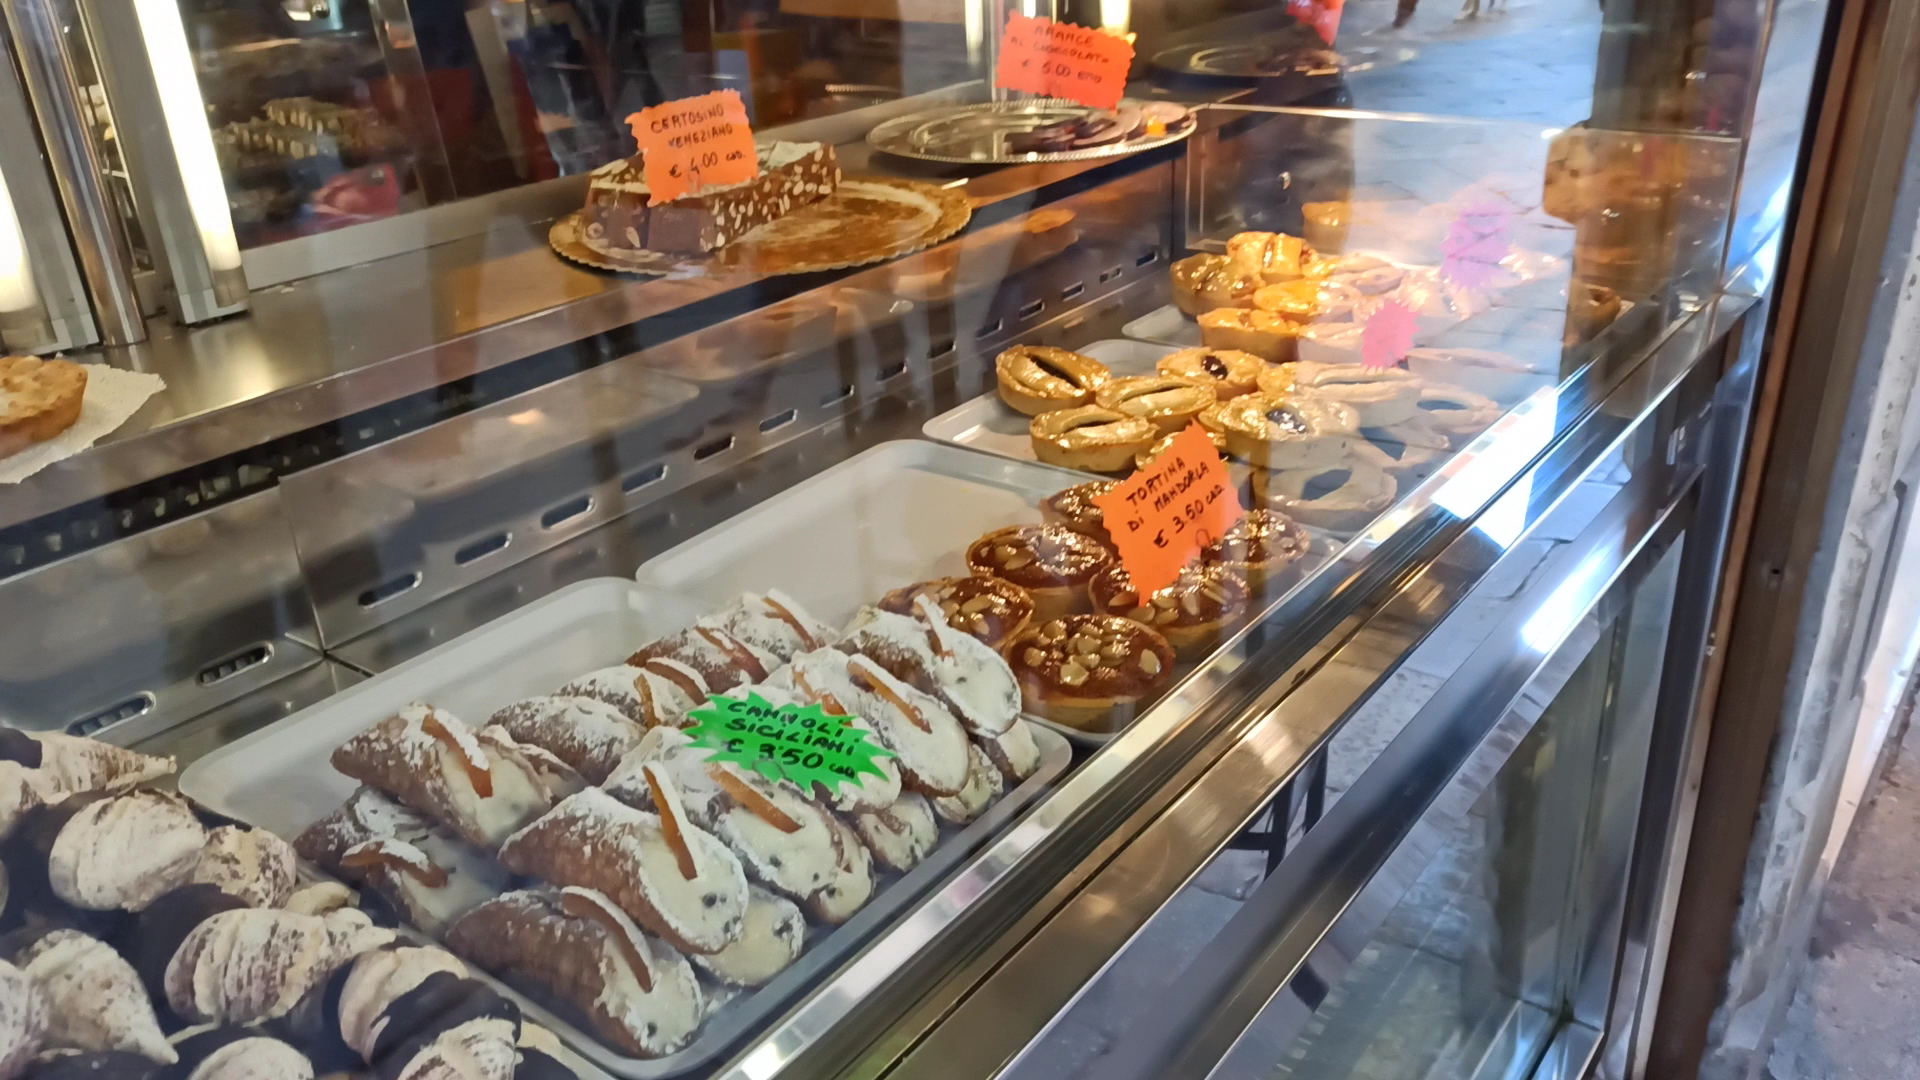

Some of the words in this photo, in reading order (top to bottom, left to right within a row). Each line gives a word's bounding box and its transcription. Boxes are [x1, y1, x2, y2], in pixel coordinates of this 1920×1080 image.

[650, 103, 724, 133] CERTOSINO
[668, 123, 733, 148] VENEZIANO
[669, 164, 682, 178] €
[1125, 457, 1186, 507] TORTINA
[1153, 461, 1210, 513] MANDORLA
[1153, 529, 1170, 548] €
[1172, 499, 1205, 534] 3.50
[724, 717, 860, 756] SICILIANI
[727, 702, 844, 737] CANNOLI
